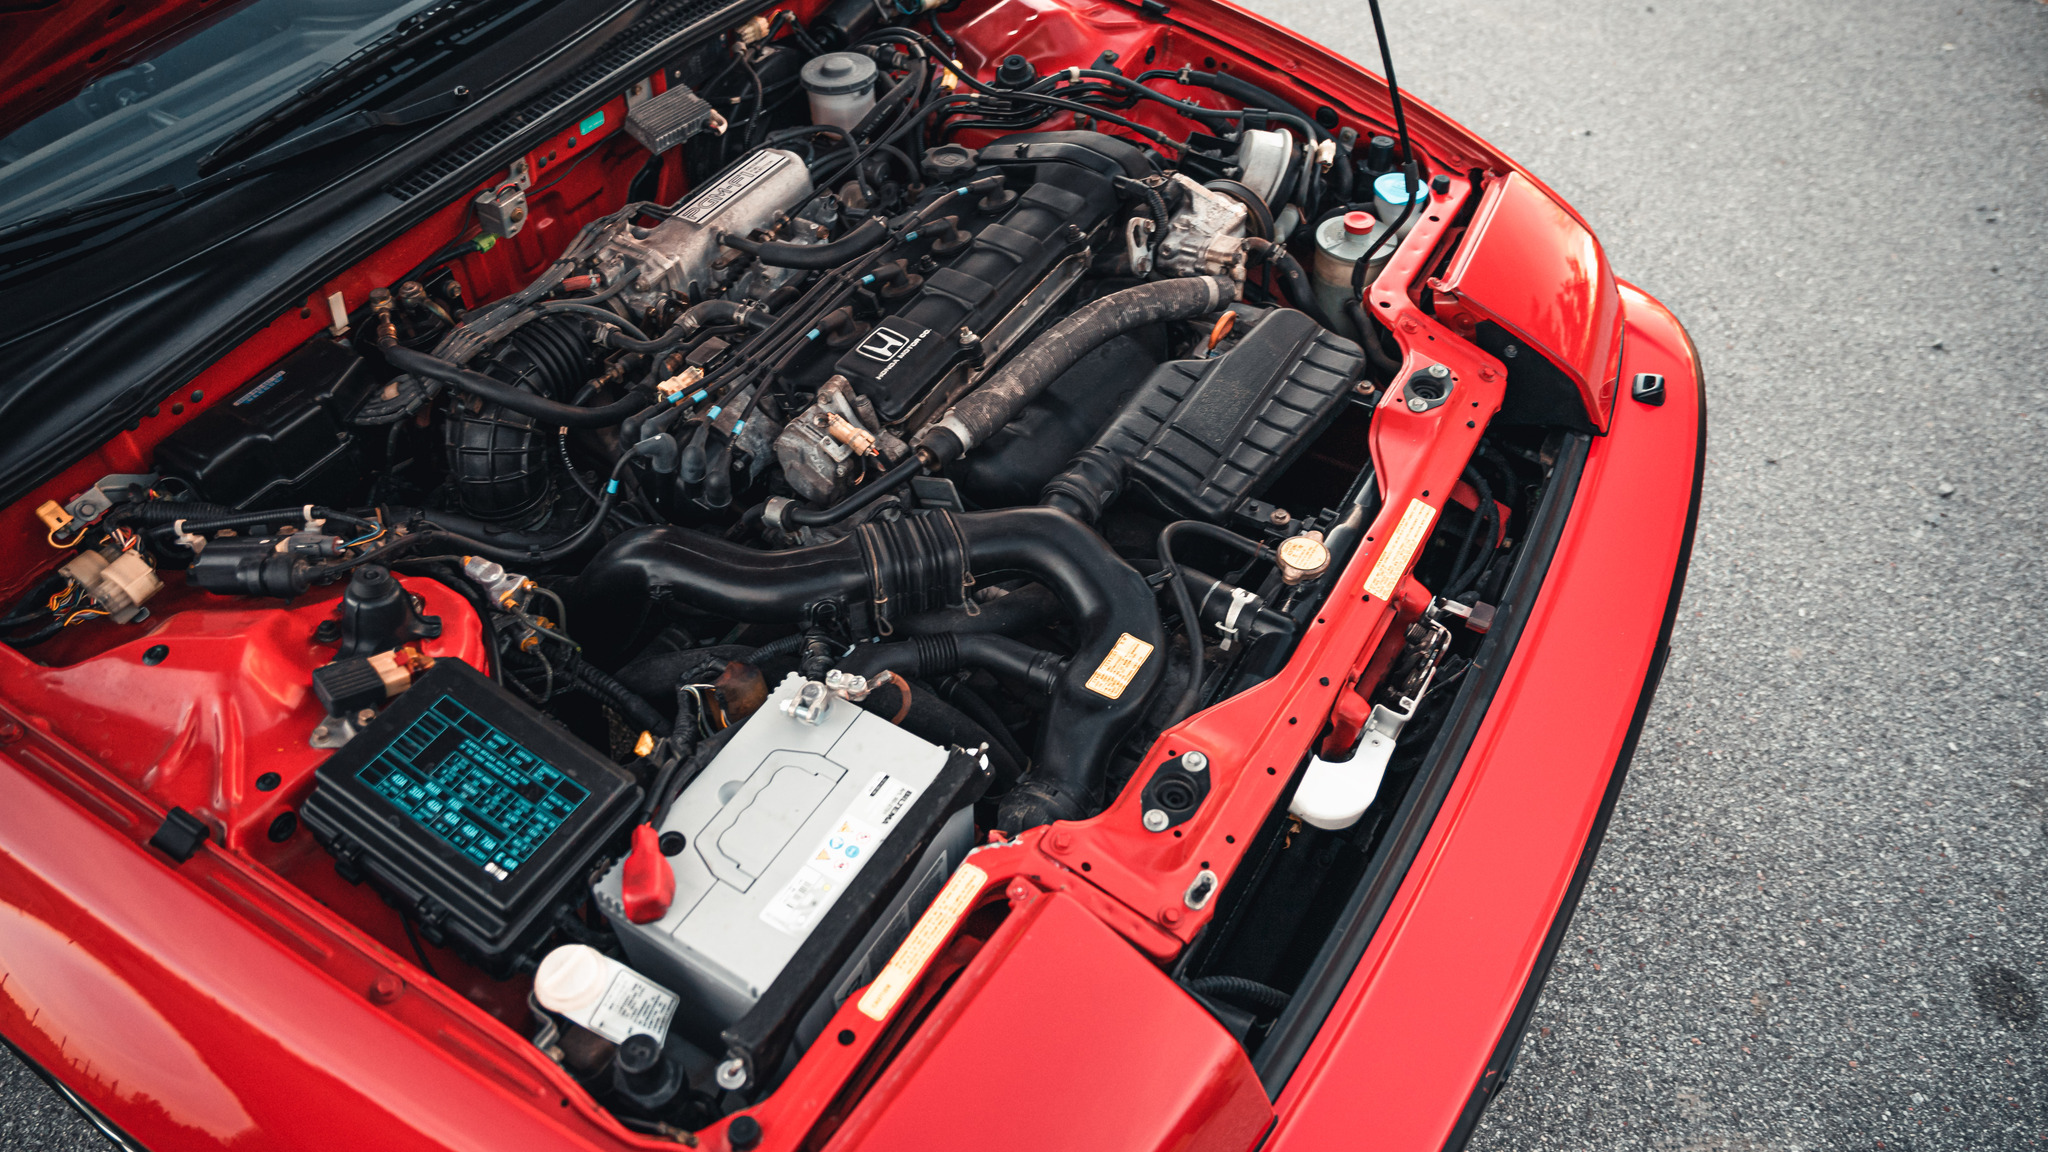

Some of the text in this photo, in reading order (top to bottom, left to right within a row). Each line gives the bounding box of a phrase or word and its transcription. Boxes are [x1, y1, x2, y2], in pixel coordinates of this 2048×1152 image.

[682, 171, 755, 220] PGM-FI
[875, 359, 900, 381] HONDA
[897, 338, 922, 359] MOTOR
[389, 772, 409, 787] 40A
[407, 785, 427, 800] 30A
[424, 781, 464, 811] MAIN FUSE
[424, 797, 444, 813] 40A
[881, 789, 913, 825] BILTEMA
[442, 810, 462, 826] 40A
[460, 822, 480, 839] 40A
[478, 835, 498, 851] 70A
